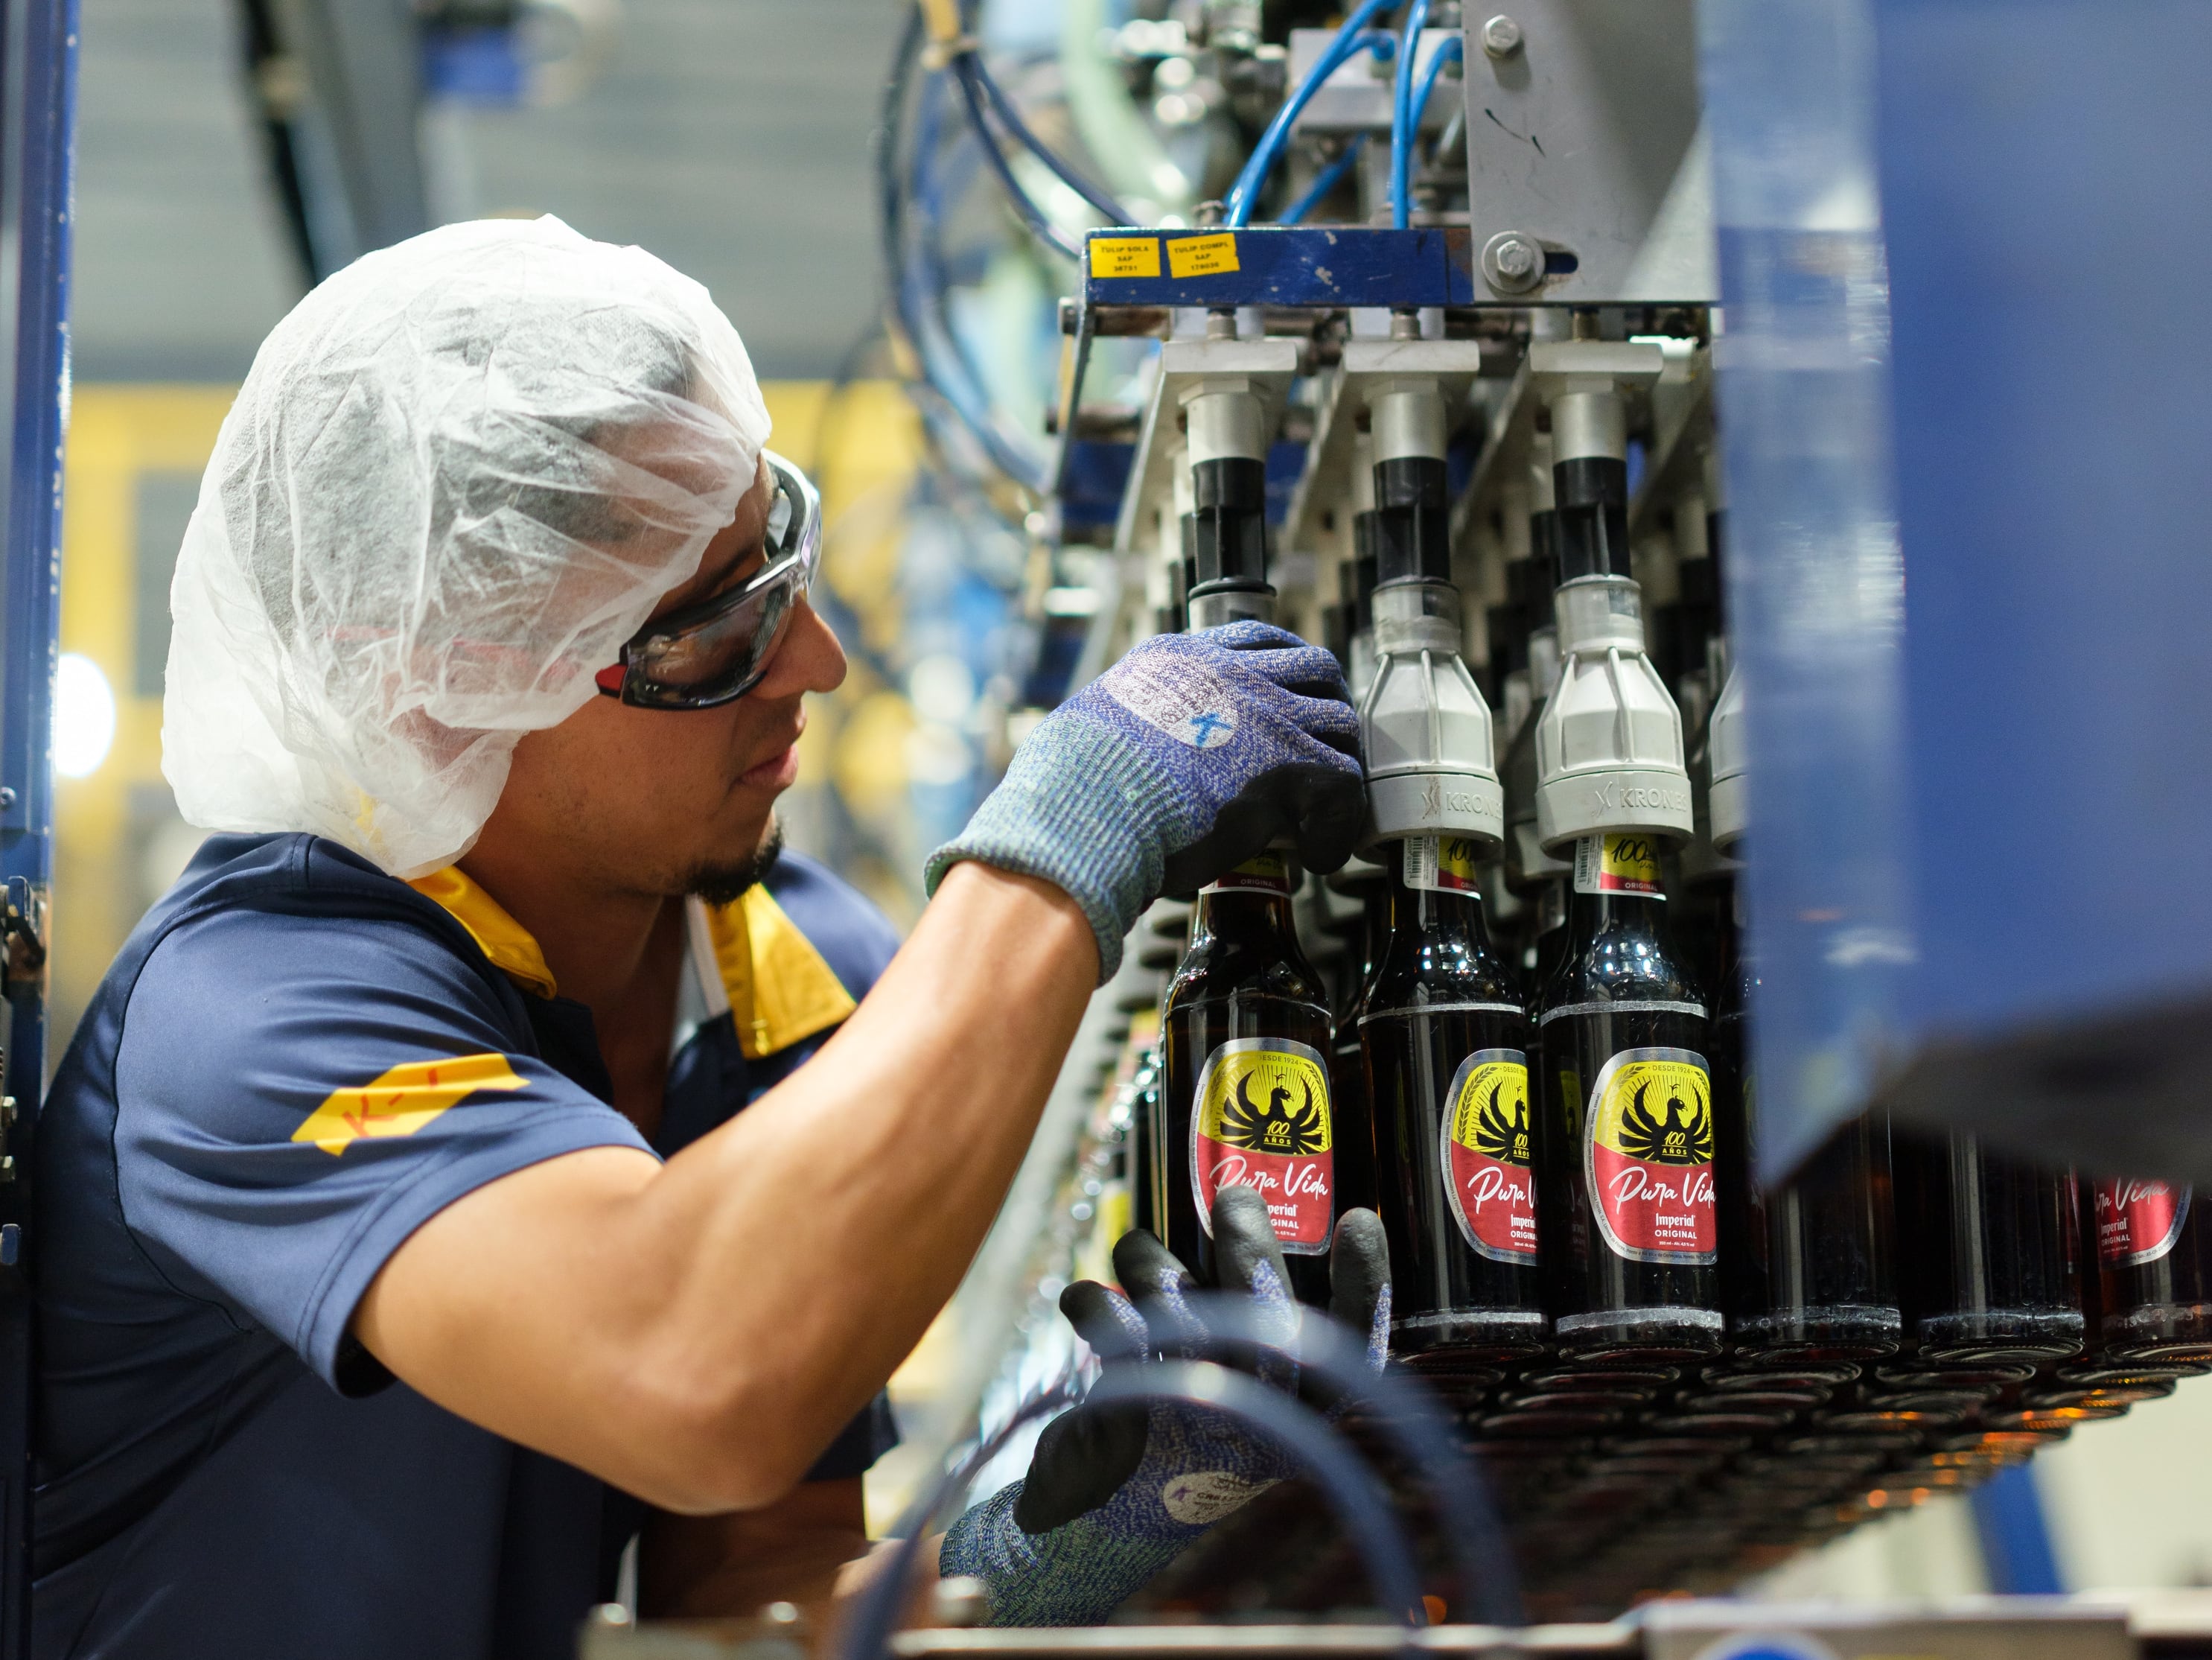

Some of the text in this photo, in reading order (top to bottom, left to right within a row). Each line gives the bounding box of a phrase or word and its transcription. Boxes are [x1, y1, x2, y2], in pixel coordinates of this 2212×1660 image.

[1174, 246, 1198, 254] TULIP
[1619, 788, 1687, 812] KRONES
[1611, 839, 1648, 863] 100
[1240, 879, 1276, 888] ORIGINAL
[1625, 882, 1658, 892] ORIGINAL
[1284, 1057, 1299, 1066] 1924
[1503, 1066, 1520, 1074] DESDE
[1677, 1066, 1691, 1075] 1924
[1266, 1120, 1291, 1135] 100
[1263, 1136, 1292, 1145] AÑOS
[1514, 1133, 1529, 1148] 100
[1664, 1130, 1686, 1145] 100
[1513, 1148, 1530, 1157] AÑOS
[1662, 1146, 1687, 1155] AÑOS
[1209, 1156, 1329, 1201] Pura Vida
[1467, 1166, 1526, 1215] Pura
[1608, 1166, 1717, 1215] Pura Vida
[1266, 1203, 1297, 1218] perial
[1271, 1220, 1299, 1230] GINAL
[1655, 1212, 1695, 1229] Imperial
[2101, 1217, 2127, 1236] Imperial
[1654, 1229, 1698, 1240] ORIGINAL
[2101, 1233, 2131, 1247] ORIGINAL
